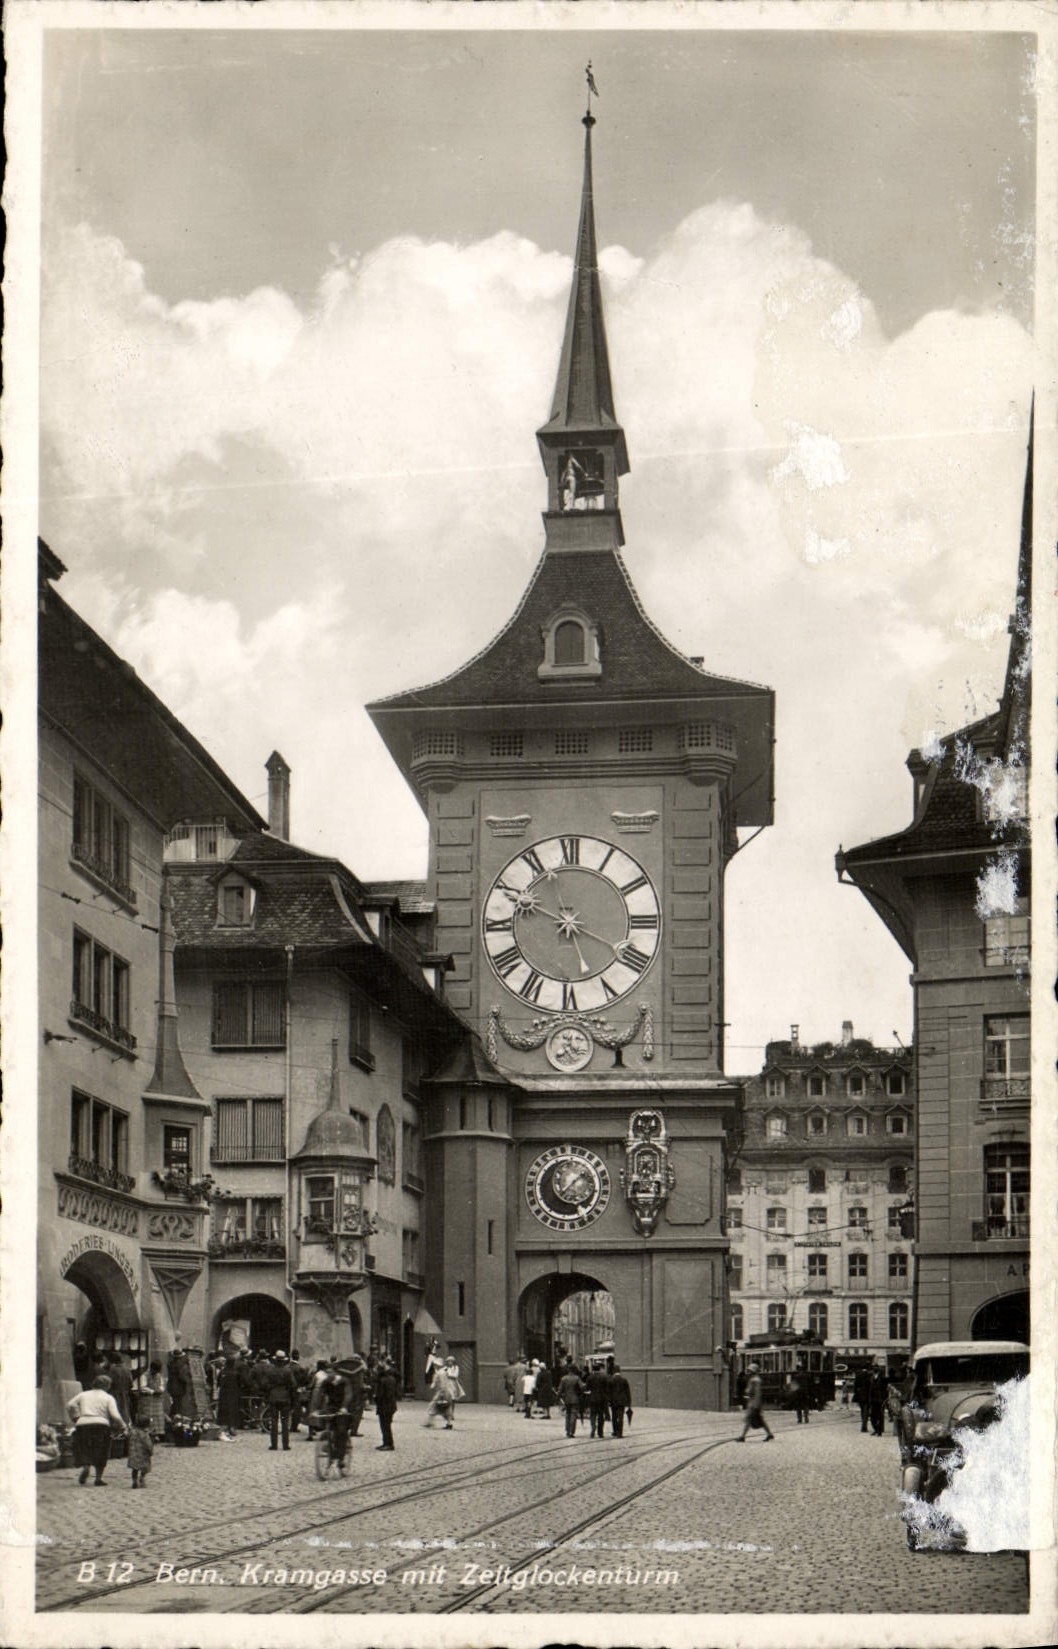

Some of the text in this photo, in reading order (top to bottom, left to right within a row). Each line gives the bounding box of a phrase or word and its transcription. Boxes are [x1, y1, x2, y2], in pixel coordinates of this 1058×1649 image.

[521, 848, 546, 879] XI
[559, 838, 580, 865] XII
[598, 847, 615, 872] I
[620, 876, 649, 896] II
[486, 917, 512, 932] IX
[630, 915, 658, 929] III
[492, 946, 522, 979] VIII
[519, 970, 544, 1004] VII
[562, 983, 578, 1010] VI
[600, 976, 619, 1001] V
